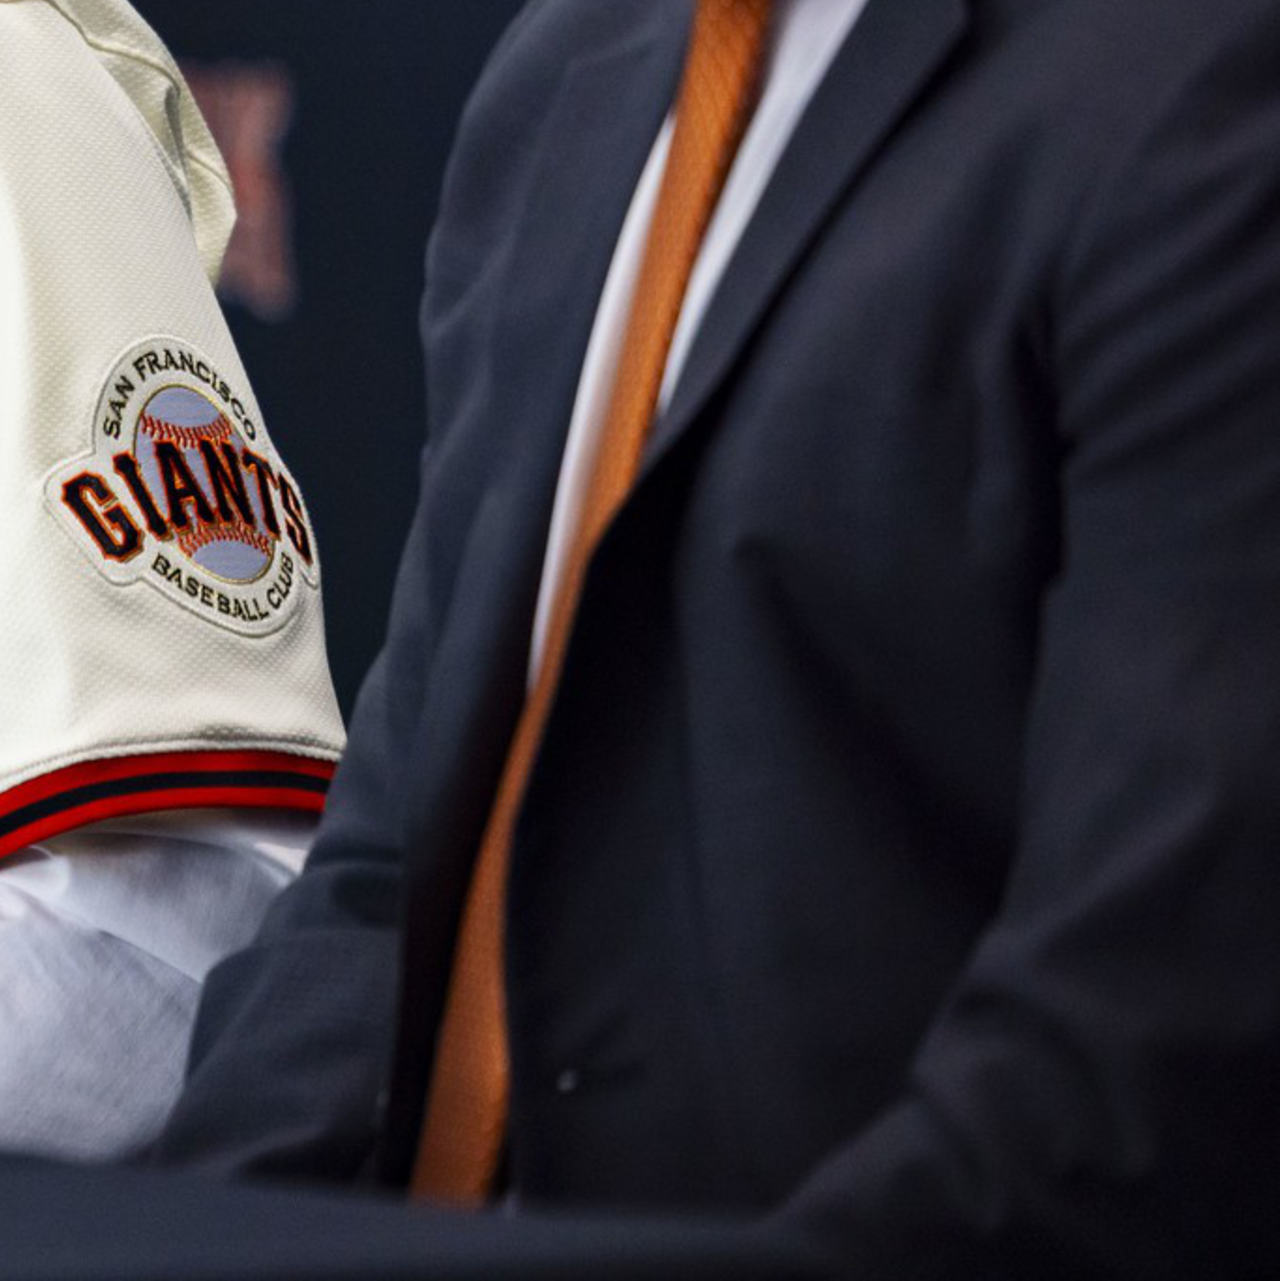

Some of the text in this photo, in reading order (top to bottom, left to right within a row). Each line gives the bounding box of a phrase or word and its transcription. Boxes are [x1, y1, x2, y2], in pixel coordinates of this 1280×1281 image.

[102, 348, 258, 443] SAN FRANCISCO
[60, 434, 314, 565] GIANTS
[151, 551, 295, 623] BASEBALL CLUB
